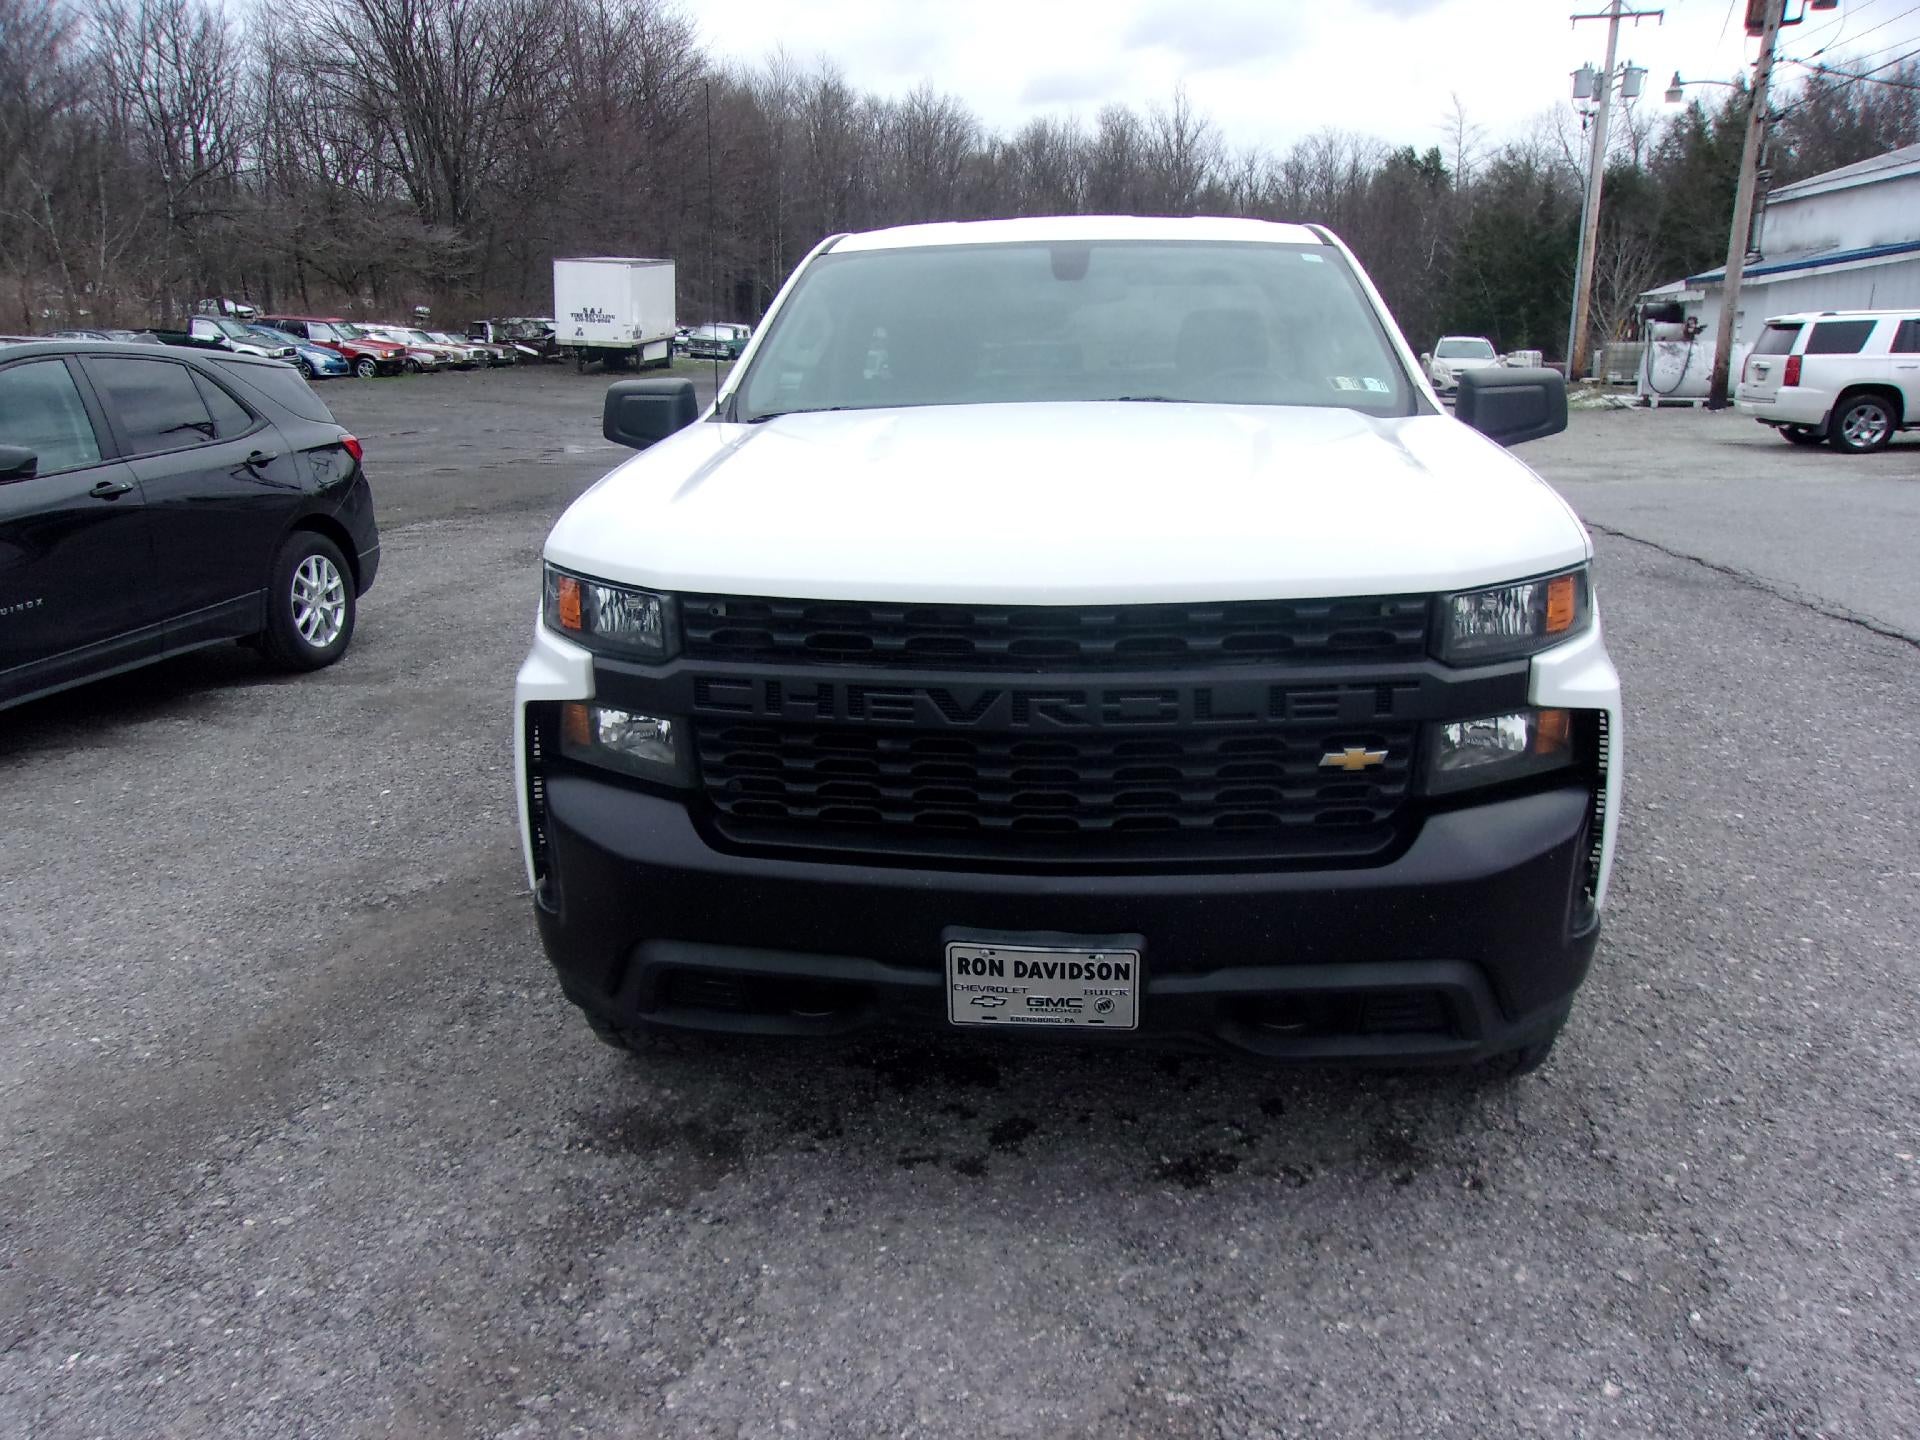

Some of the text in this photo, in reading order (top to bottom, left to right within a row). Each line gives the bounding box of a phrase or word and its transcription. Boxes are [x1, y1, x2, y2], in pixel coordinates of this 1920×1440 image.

[694, 677, 1420, 726] CHEVROLET
[957, 957, 1130, 981] RON DAVIDSON
[954, 983, 1029, 994] CHEVROLET
[1084, 988, 1129, 997] BUICK
[1026, 996, 1083, 1008] GMC
